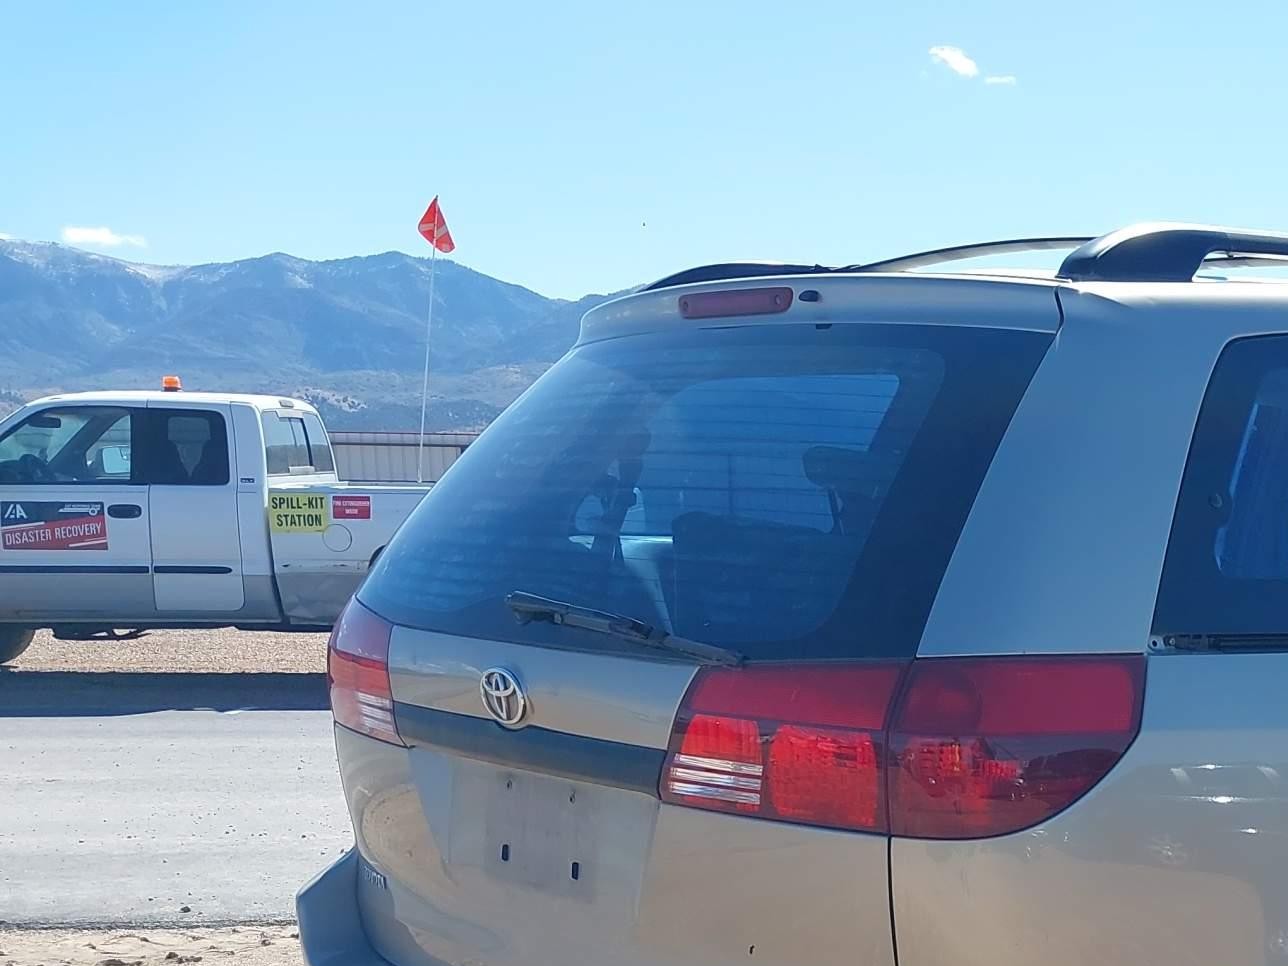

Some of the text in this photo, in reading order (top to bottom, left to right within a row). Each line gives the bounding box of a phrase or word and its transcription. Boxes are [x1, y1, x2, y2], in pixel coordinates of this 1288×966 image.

[271, 496, 325, 510] SPILL-KIT
[276, 513, 322, 527] STATION
[5, 521, 102, 546] DISASTER RECOVERY
